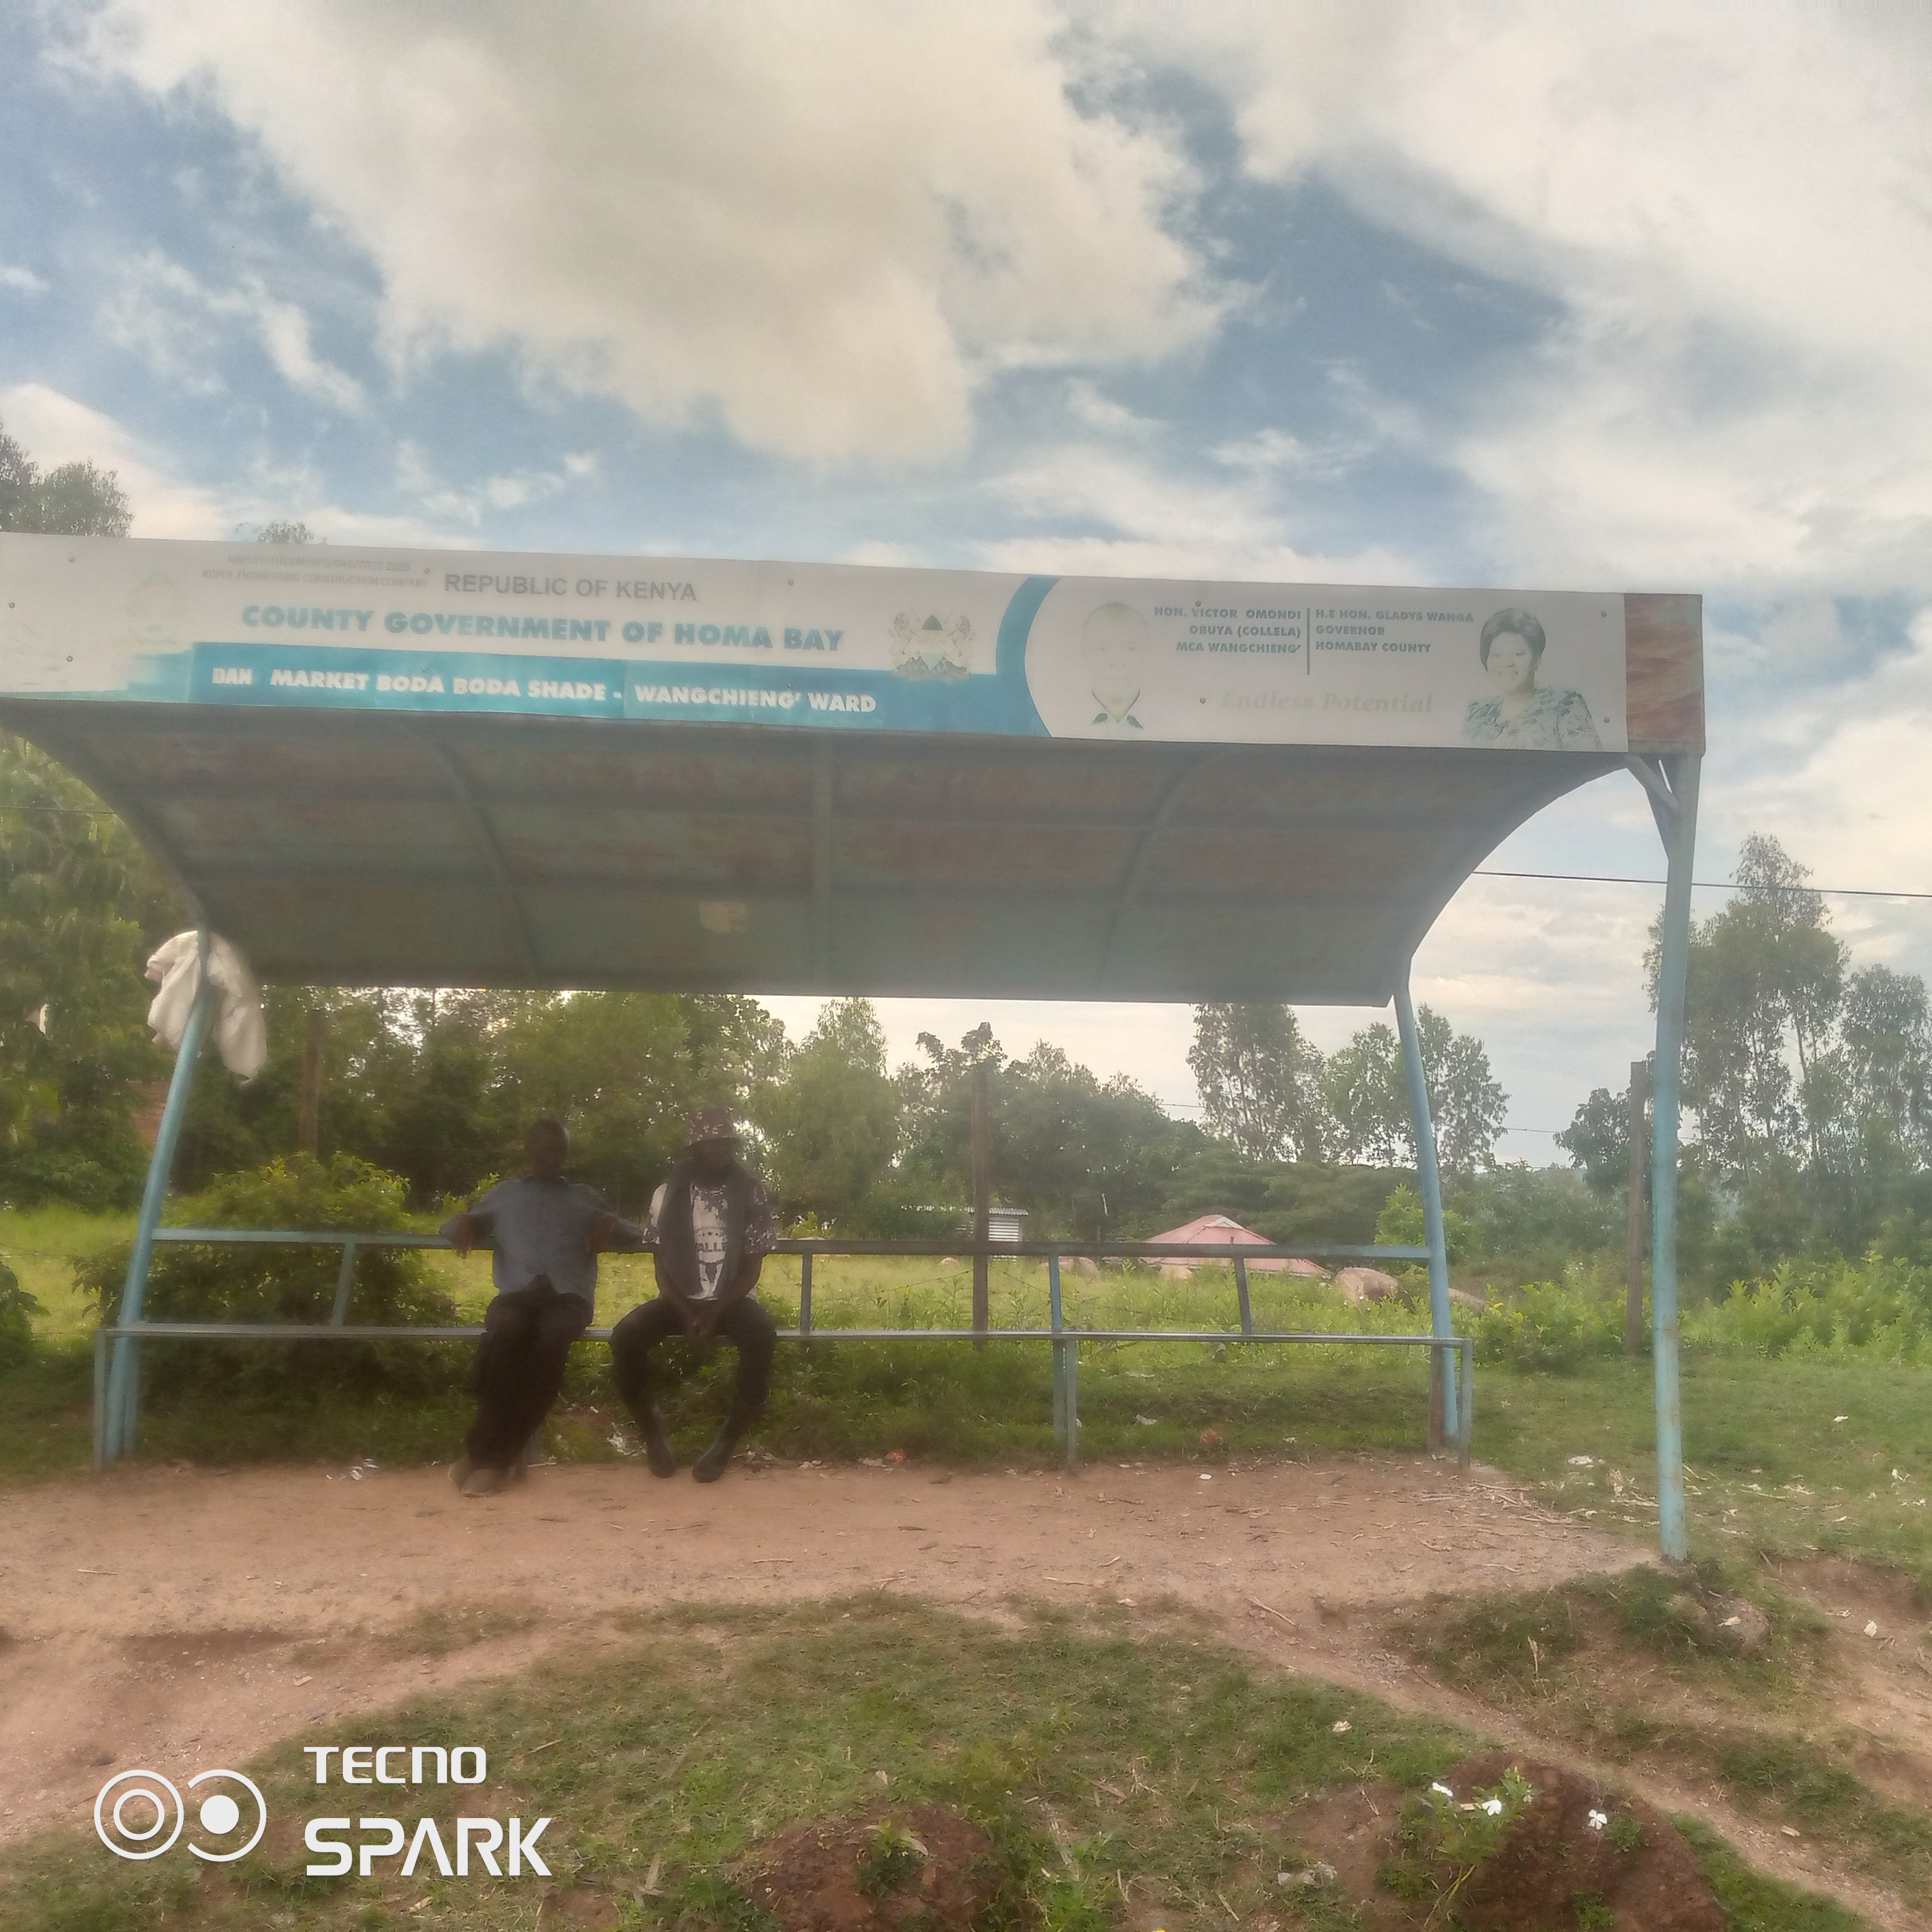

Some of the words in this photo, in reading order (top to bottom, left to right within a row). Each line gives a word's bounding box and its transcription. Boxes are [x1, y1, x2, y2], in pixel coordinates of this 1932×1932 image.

[237, 571, 299, 583] ENGINEERING
[302, 573, 378, 586] CONSTRUCTION
[380, 577, 428, 588] COMPANY
[444, 573, 567, 596] REPUBLIC
[576, 578, 607, 598] OF
[617, 581, 697, 601] KENYA
[1155, 606, 1187, 617] HON.
[1191, 607, 1237, 619] VICTOR
[1246, 609, 1301, 620] OMONDI
[1316, 609, 1336, 619] H.E
[1340, 609, 1371, 620] HON.
[1376, 611, 1423, 621] GLADYS
[1427, 612, 1474, 622] WANGA
[242, 604, 374, 631] COUNTY
[384, 612, 611, 642] GOVERNMENT
[622, 620, 664, 644] OF
[674, 623, 773, 649] HOMA
[784, 627, 845, 651] BAY
[1189, 625, 1233, 636] OBUYA
[1237, 626, 1301, 639] (COLLELA)
[1316, 625, 1385, 636] GOVERNOR
[1176, 641, 1204, 652] MCA
[1315, 640, 1377, 652] HOMABAY
[1382, 642, 1432, 653] COUNTY
[270, 668, 370, 690] MARKET
[376, 674, 445, 693] BODA
[453, 677, 522, 697] BODA
[527, 678, 607, 701] SHADE
[807, 692, 878, 713] WARD
[1221, 690, 1314, 710] Endless
[1321, 692, 1432, 713] Potential
